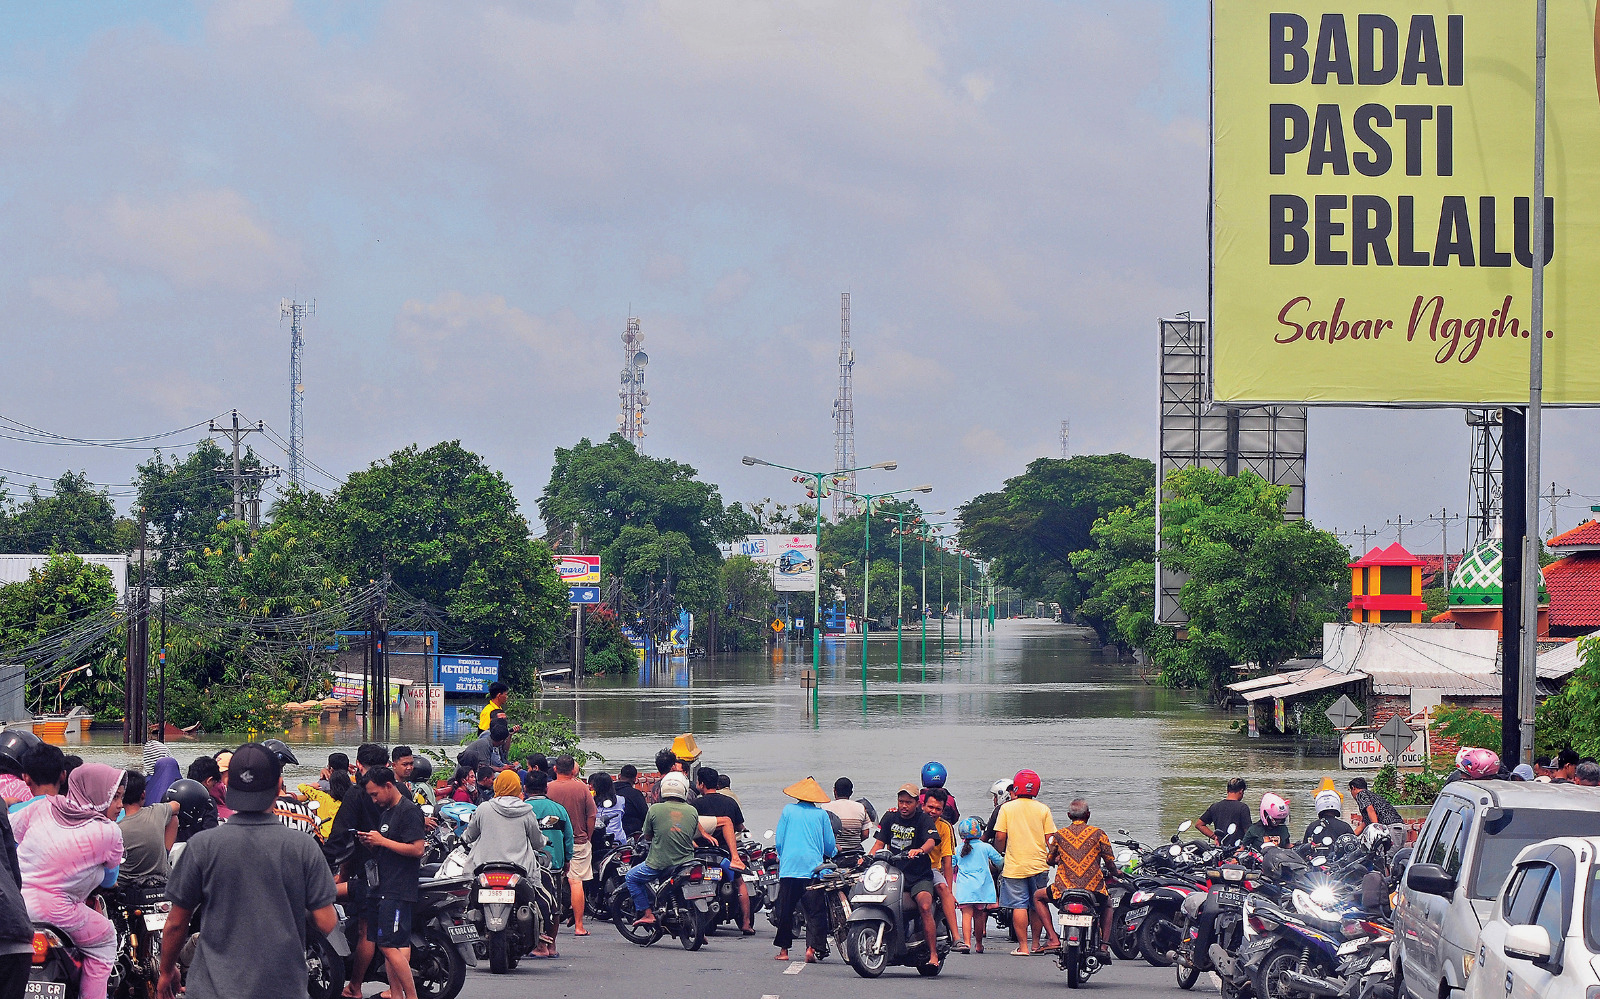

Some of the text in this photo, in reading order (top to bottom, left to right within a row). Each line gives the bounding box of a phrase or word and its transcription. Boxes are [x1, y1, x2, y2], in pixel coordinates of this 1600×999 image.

[1269, 13, 1463, 86] BADAI
[1269, 103, 1453, 177] PASTI
[1269, 194, 1554, 269] BERLALU
[1274, 295, 1554, 363] Sabar Nggih..
[742, 542, 760, 556] CLAS
[1342, 740, 1375, 754] KETOG
[47, 985, 61, 995] CR
